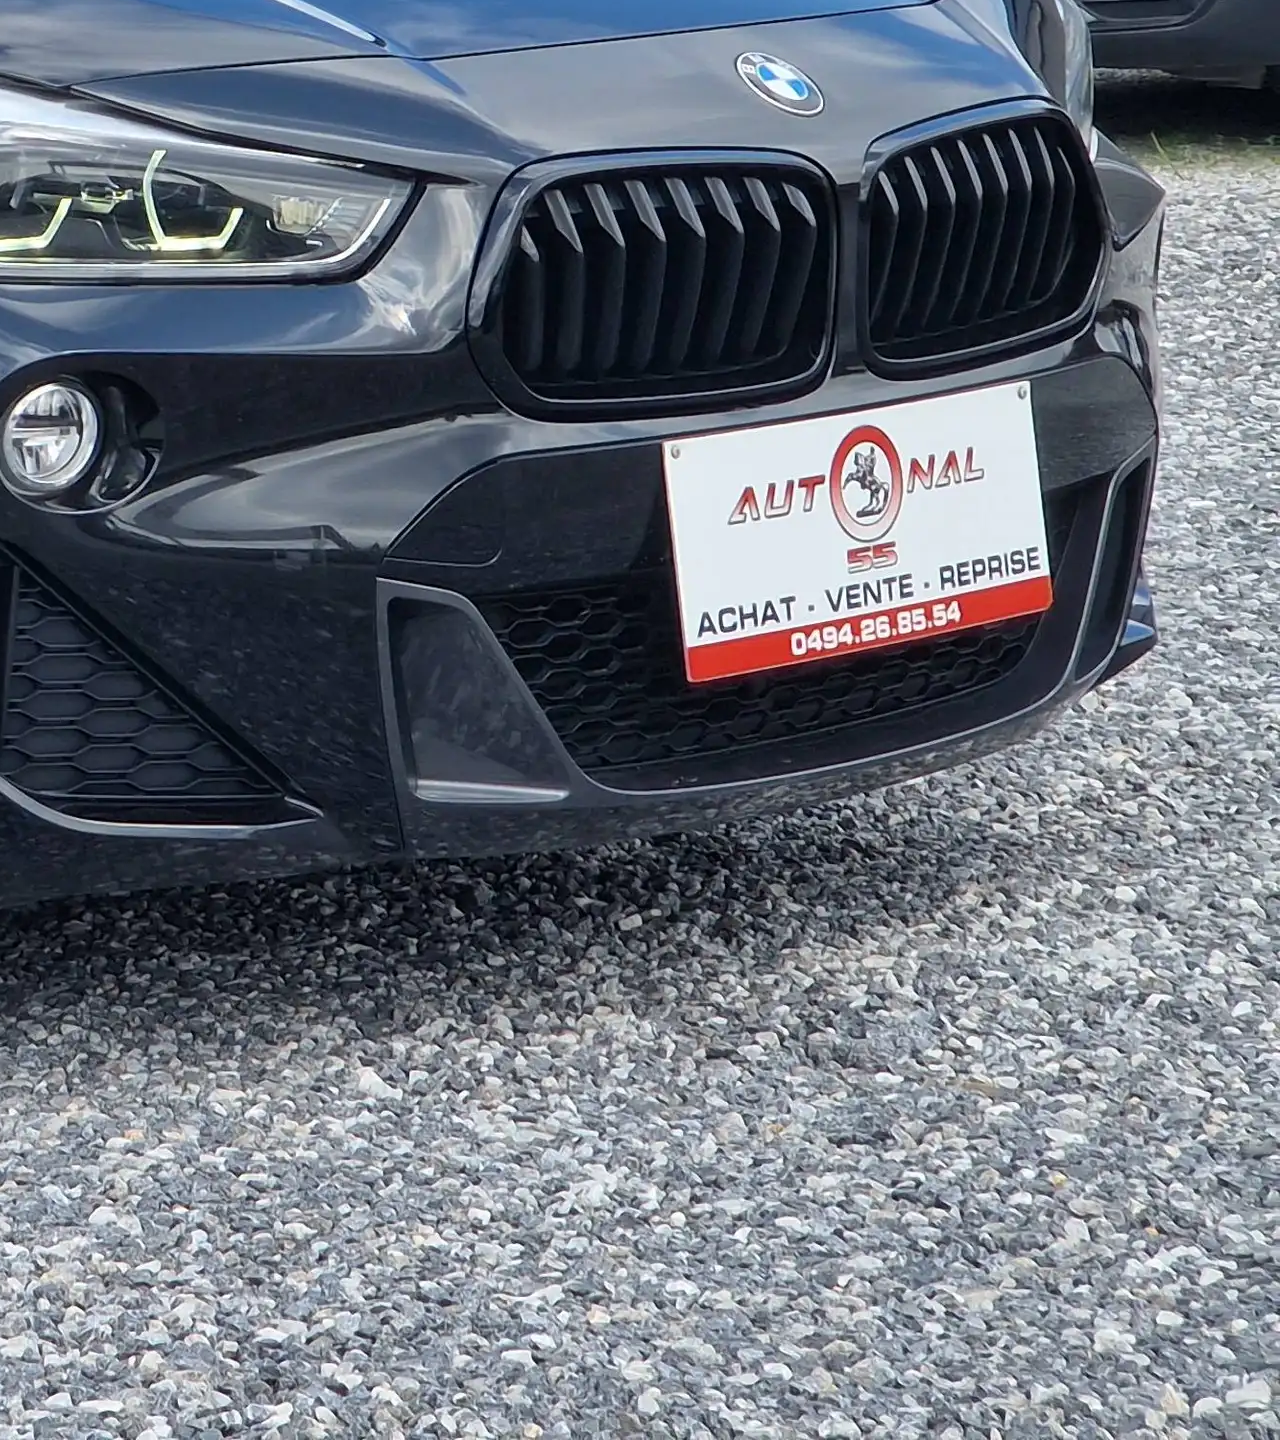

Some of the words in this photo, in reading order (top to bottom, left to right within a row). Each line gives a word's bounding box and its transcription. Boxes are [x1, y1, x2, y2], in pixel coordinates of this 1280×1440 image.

[846, 541, 899, 574] 55
[697, 595, 797, 638] ACHAT
[824, 573, 915, 613] VENTE
[938, 545, 1042, 591] REPRISE
[790, 600, 963, 657] 0494.26.85.54
